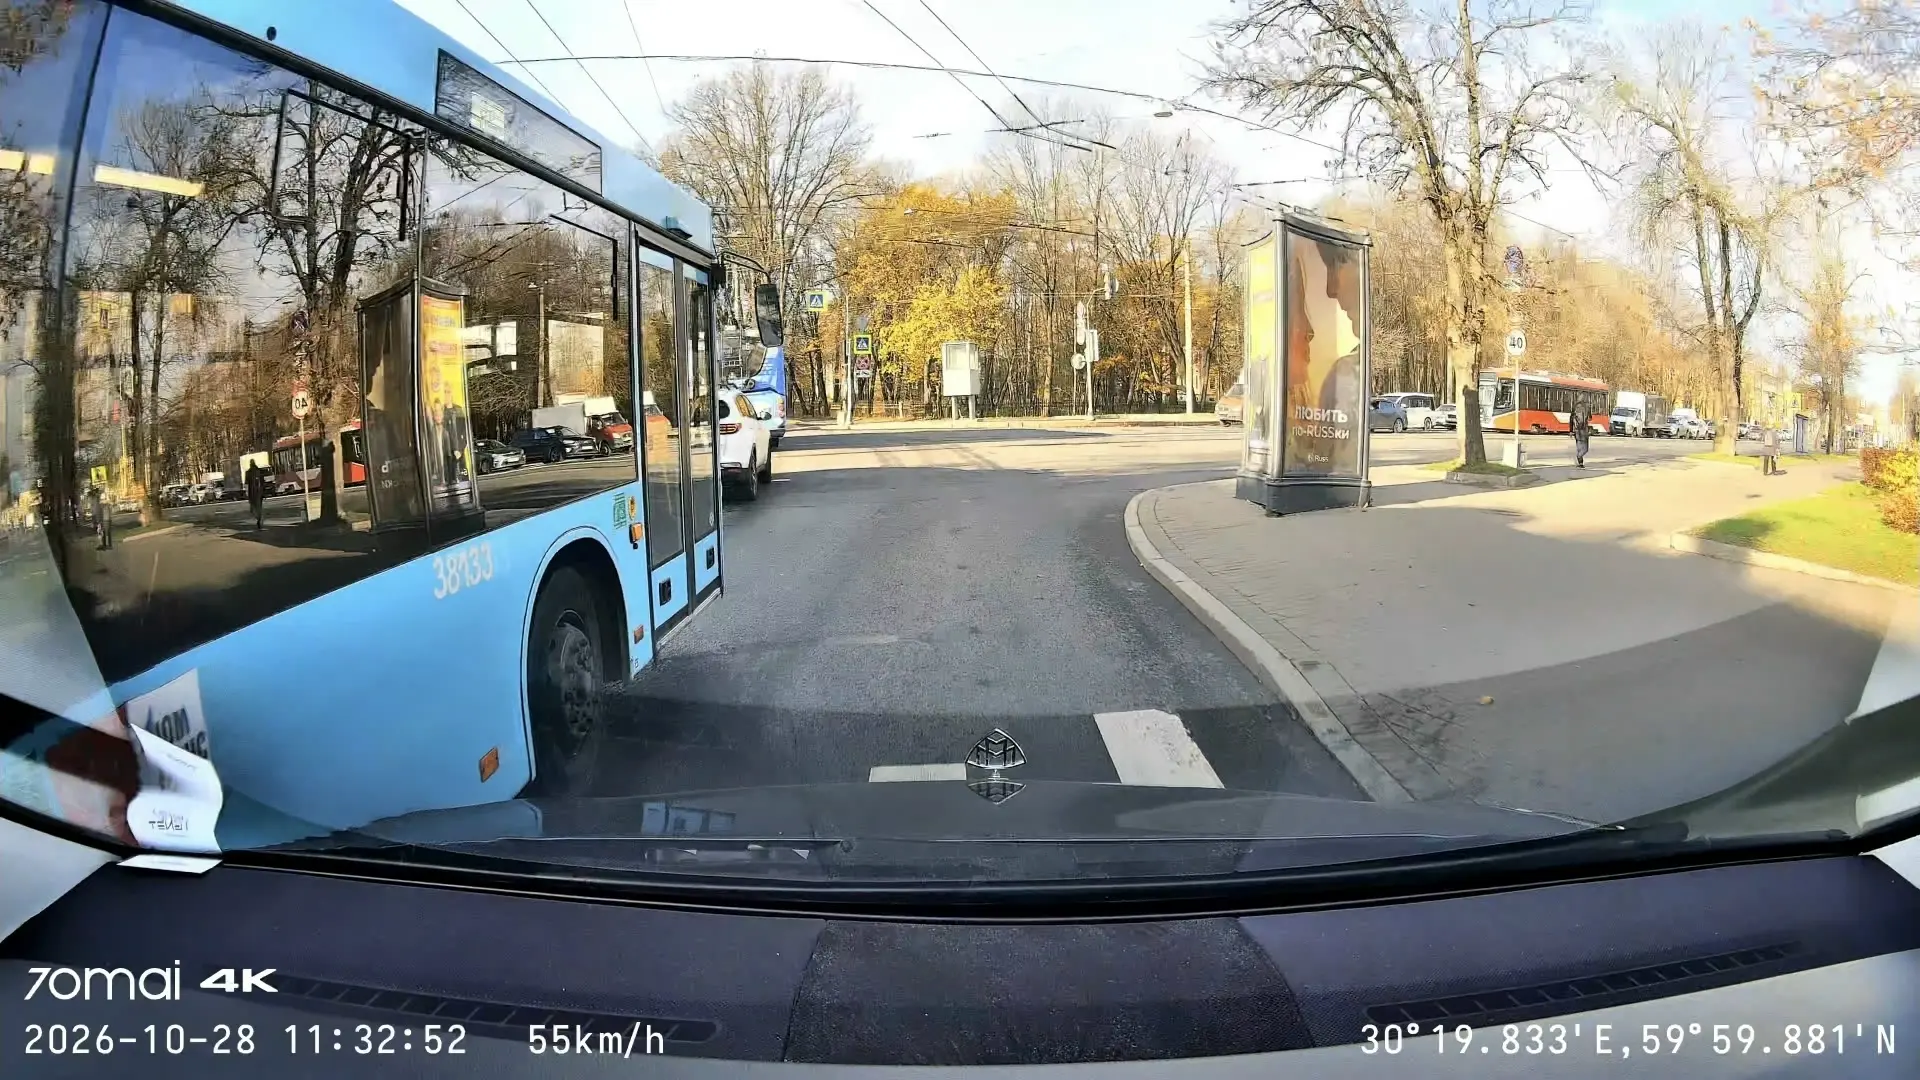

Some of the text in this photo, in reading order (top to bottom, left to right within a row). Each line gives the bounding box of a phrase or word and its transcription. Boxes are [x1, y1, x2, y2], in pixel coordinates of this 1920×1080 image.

[1508, 336, 1523, 349] 40
[1294, 404, 1348, 423] ЛЮБИТЬ
[1314, 454, 1329, 463] Russ
[432, 542, 494, 600] 38133
